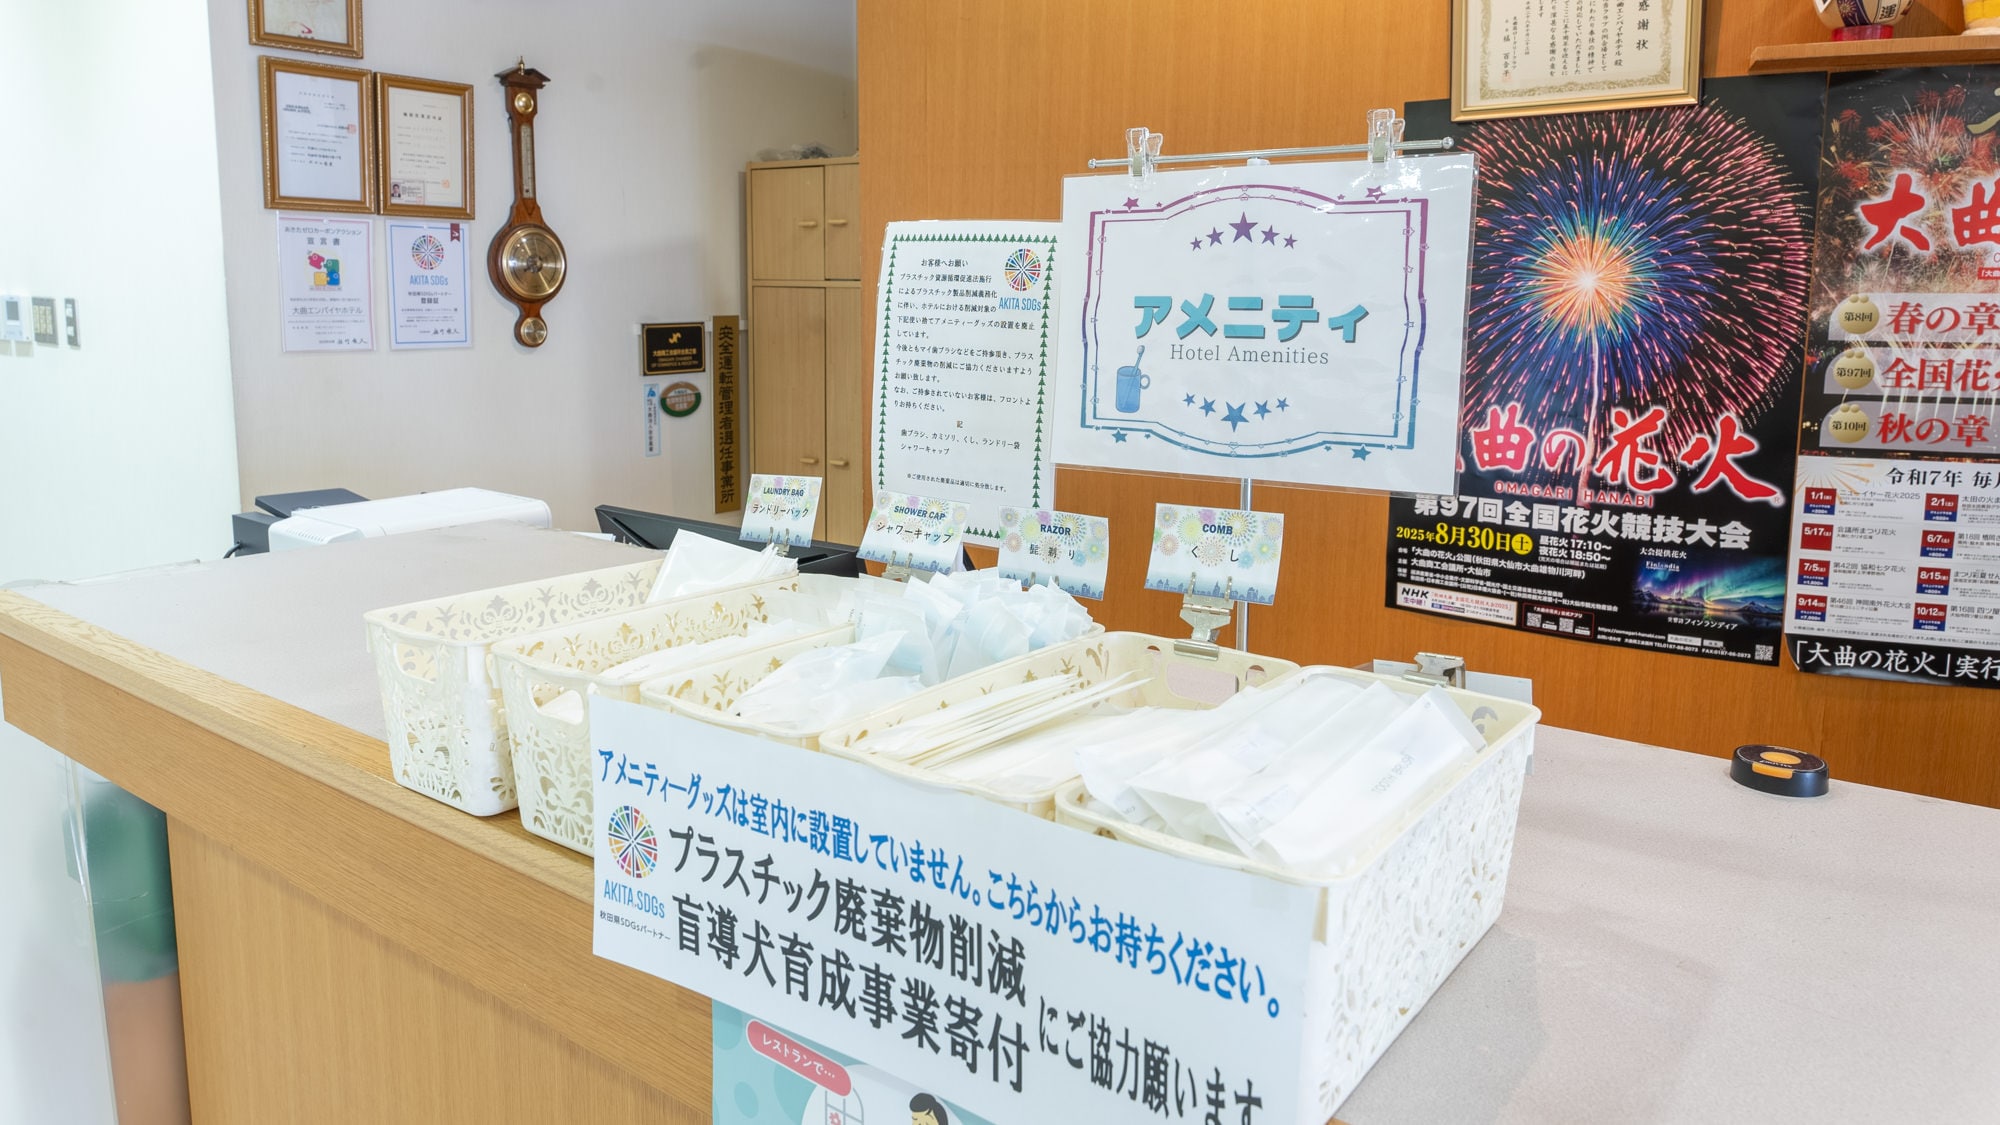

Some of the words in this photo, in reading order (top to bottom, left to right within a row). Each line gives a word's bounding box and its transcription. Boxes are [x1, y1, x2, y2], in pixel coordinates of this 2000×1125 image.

[921, 258, 969, 268] お客様へお願い
[409, 274, 430, 285] AKITA
[430, 275, 448, 286] SDGs
[897, 302, 997, 313] に伴い、ホテルにおける削減対象の
[998, 297, 1020, 310] AKITA
[1021, 298, 1041, 312] SDGs
[1134, 292, 1370, 343] アメニティ
[1843, 310, 1873, 323] 第8回
[1887, 301, 2000, 337] 春の章
[897, 330, 929, 339] しています。
[1169, 344, 1221, 361] Hotel
[1227, 345, 1329, 365] Amenities
[894, 372, 941, 383] お願い致します。
[1836, 366, 1872, 379] 第97回
[1881, 357, 2000, 392] 全国花
[894, 400, 946, 412] りお持ちください。
[719, 325, 734, 504] 安全運転管理者選任事業所
[956, 420, 964, 429] 記
[1831, 419, 1867, 433] 第10回
[1876, 411, 1990, 448] 秋の章
[900, 443, 950, 455] シャワーキャップ
[1456, 403, 1781, 501] 曲の花火
[1886, 467, 1963, 488] 令和7年
[763, 487, 791, 496] LAUNDRY
[791, 488, 804, 497] BAG
[1494, 479, 1573, 502] OMAGARI
[1583, 489, 1654, 509] HANABI
[893, 505, 928, 518] SHOWER
[928, 509, 946, 521] CAP
[1039, 522, 1072, 538] RAZOR
[1201, 522, 1234, 536] COMB
[1414, 494, 1752, 550] 第97回全国花火競技大会
[876, 521, 954, 544] シャワーキャップ
[1837, 525, 1897, 536] 会議所まつり花火
[1539, 545, 1568, 558] 夜花火
[1639, 547, 1687, 559] 大会提供花火
[1646, 560, 1680, 570] Finlandia
[1401, 587, 1430, 600] NHK
[599, 749, 1280, 1019] アメニティーグッズは室内に設置していません。こちらからお持ちください。
[603, 879, 634, 907] AKITA
[636, 888, 666, 919] SDGs
[669, 825, 1027, 1007] プラスチック廃棄物削減
[599, 909, 671, 941] 秋田県SDGsパートナー
[672, 892, 1030, 1094] 盲導犬育成事業寄付
